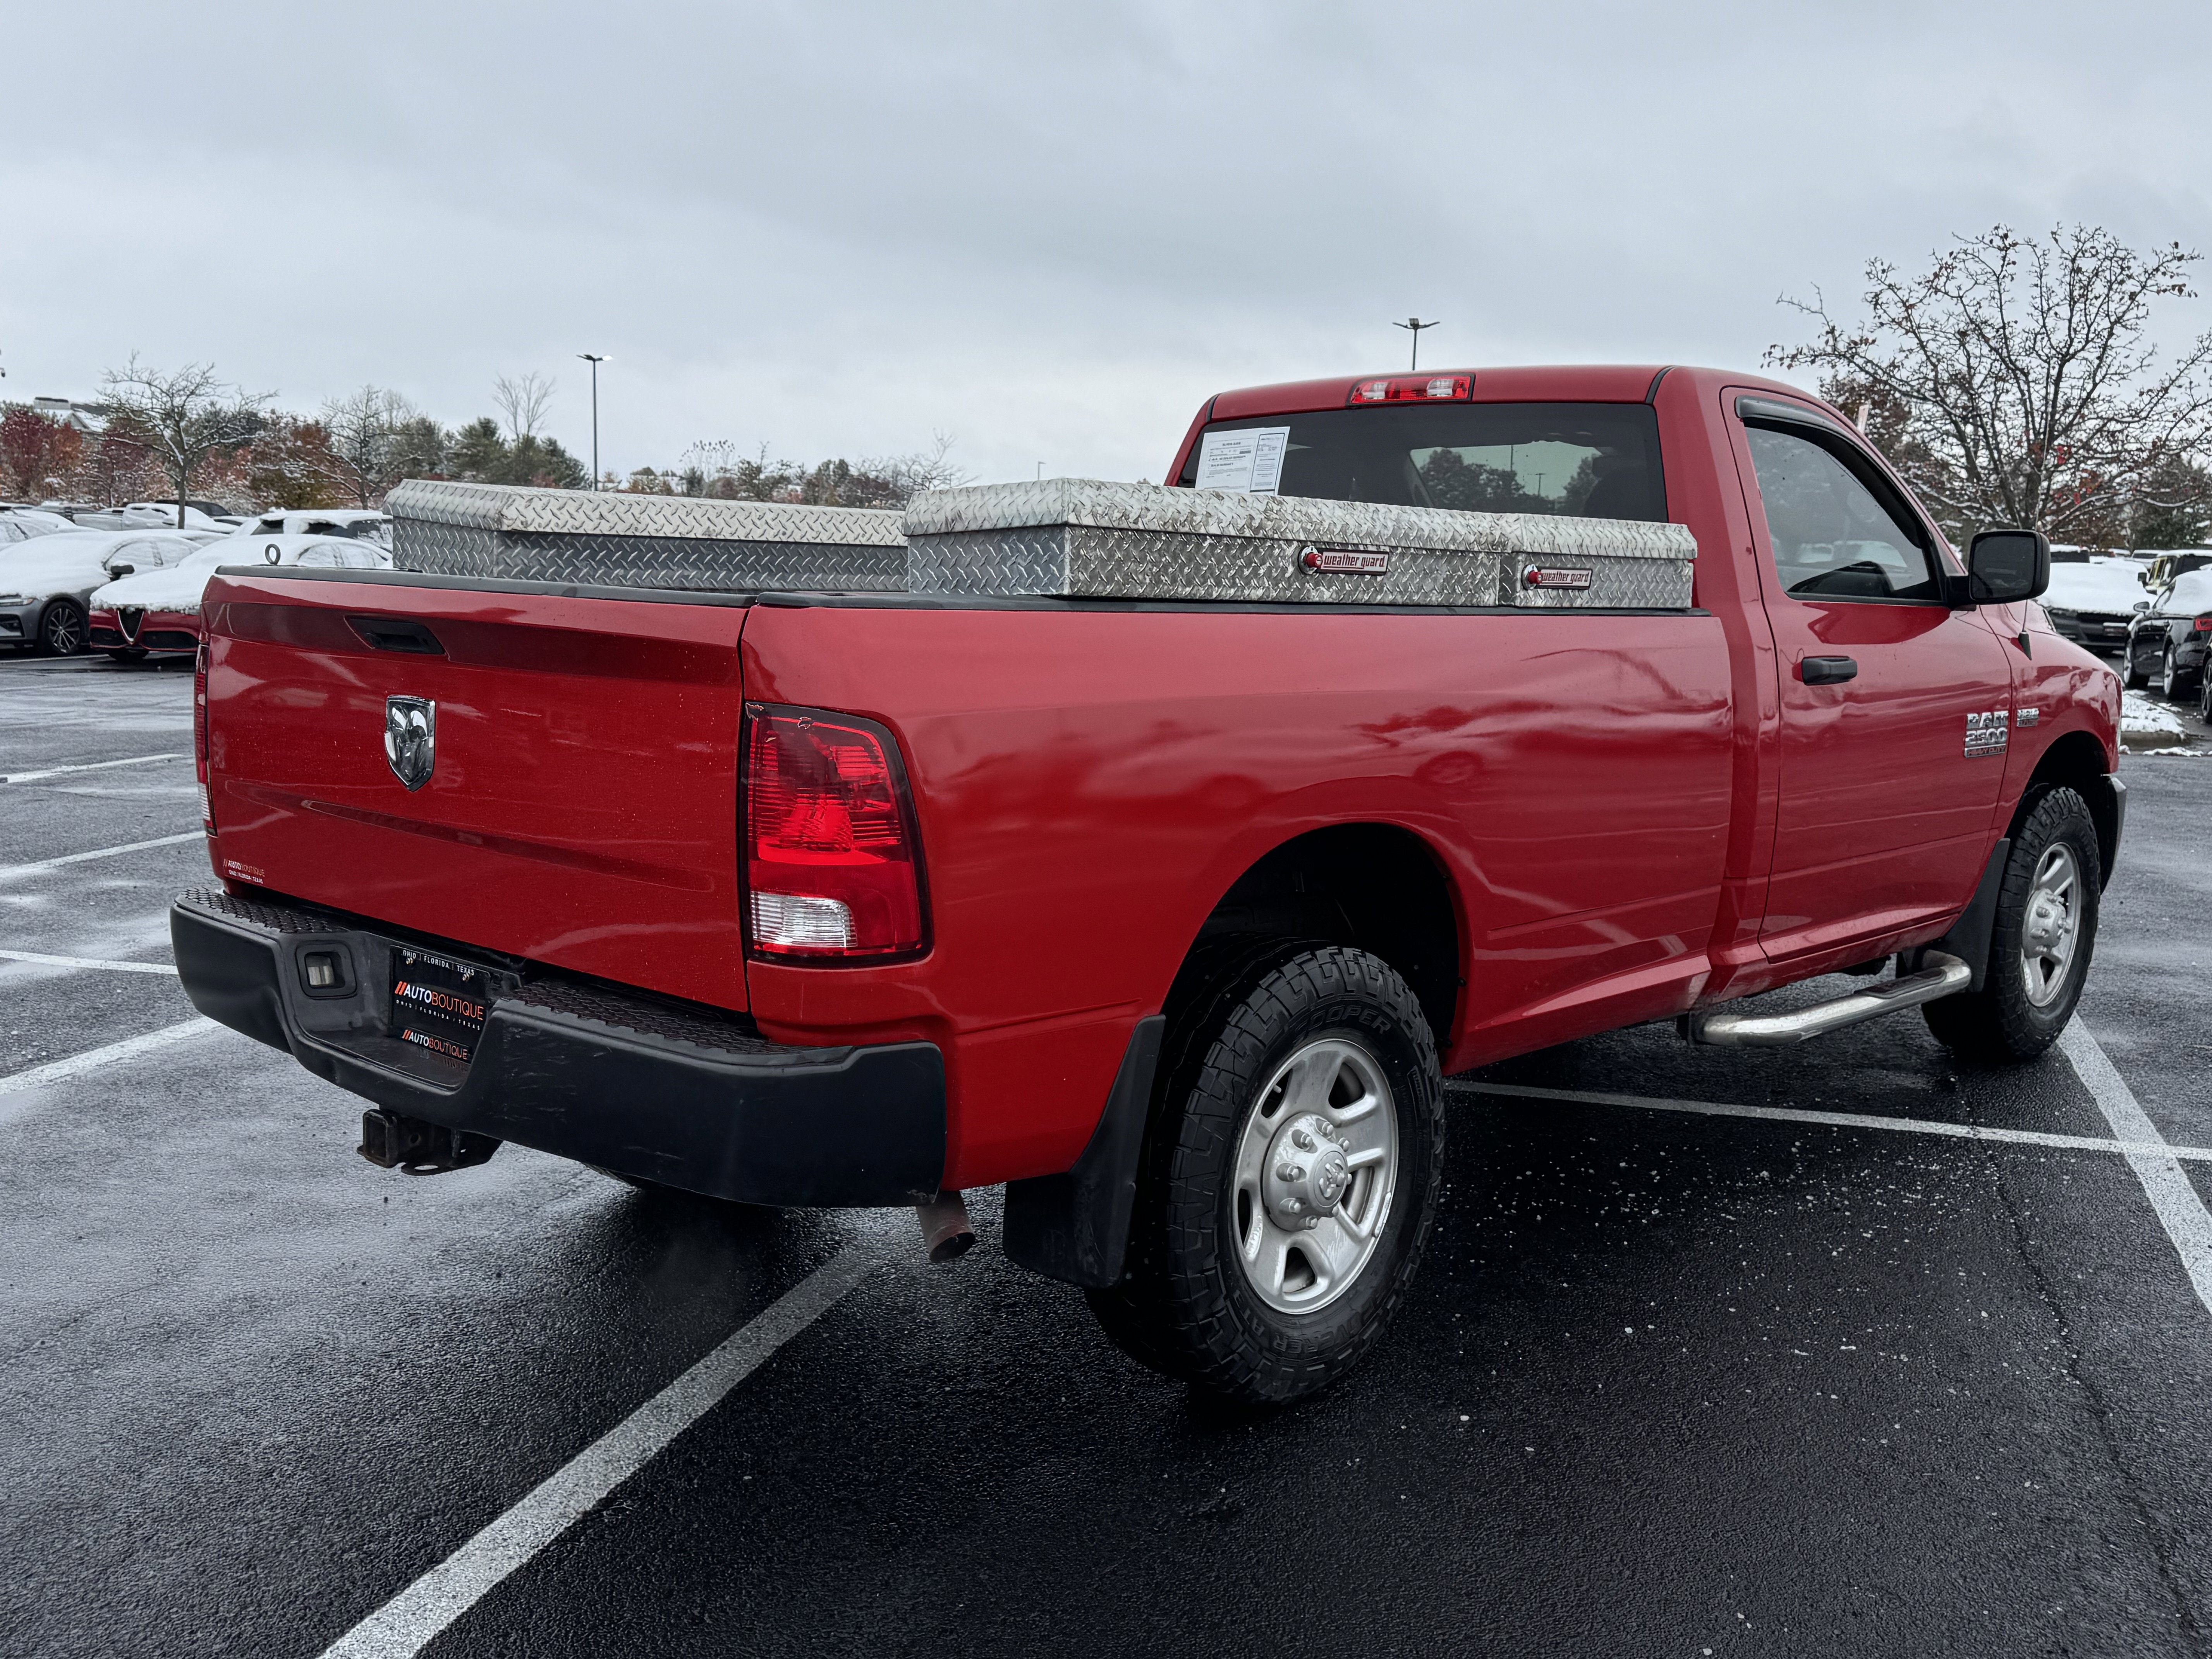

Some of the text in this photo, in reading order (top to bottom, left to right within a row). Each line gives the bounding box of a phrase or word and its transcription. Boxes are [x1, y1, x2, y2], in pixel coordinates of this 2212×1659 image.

[1324, 554, 1385, 569] weather guard
[1542, 571, 1590, 584] weather guard
[1966, 710, 2009, 729] RAM
[1965, 727, 2008, 746] 2500
[403, 950, 474, 976] OHIO FLORIDA TEXAS
